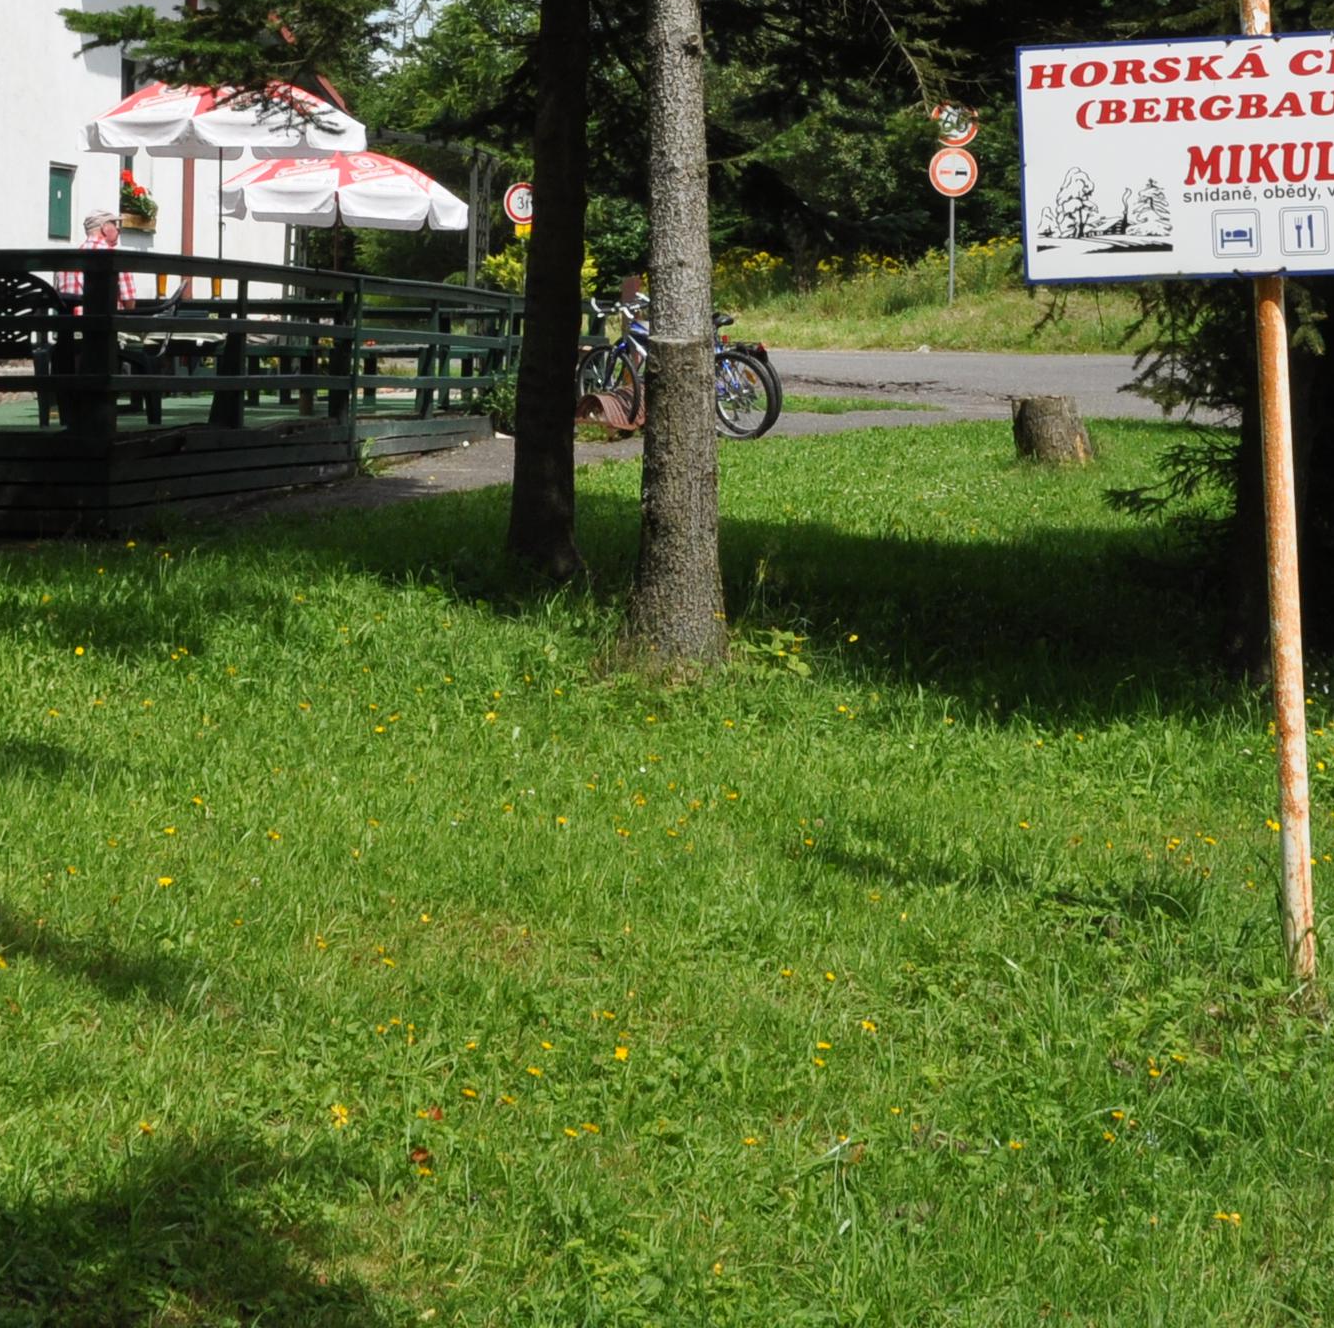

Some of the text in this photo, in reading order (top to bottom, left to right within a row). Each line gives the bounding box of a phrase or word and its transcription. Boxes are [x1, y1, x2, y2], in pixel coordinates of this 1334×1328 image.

[1026, 45, 1270, 90] HORSKÁ
[1182, 185, 1257, 203] snídaně,
[1263, 183, 1322, 201] obědy,
